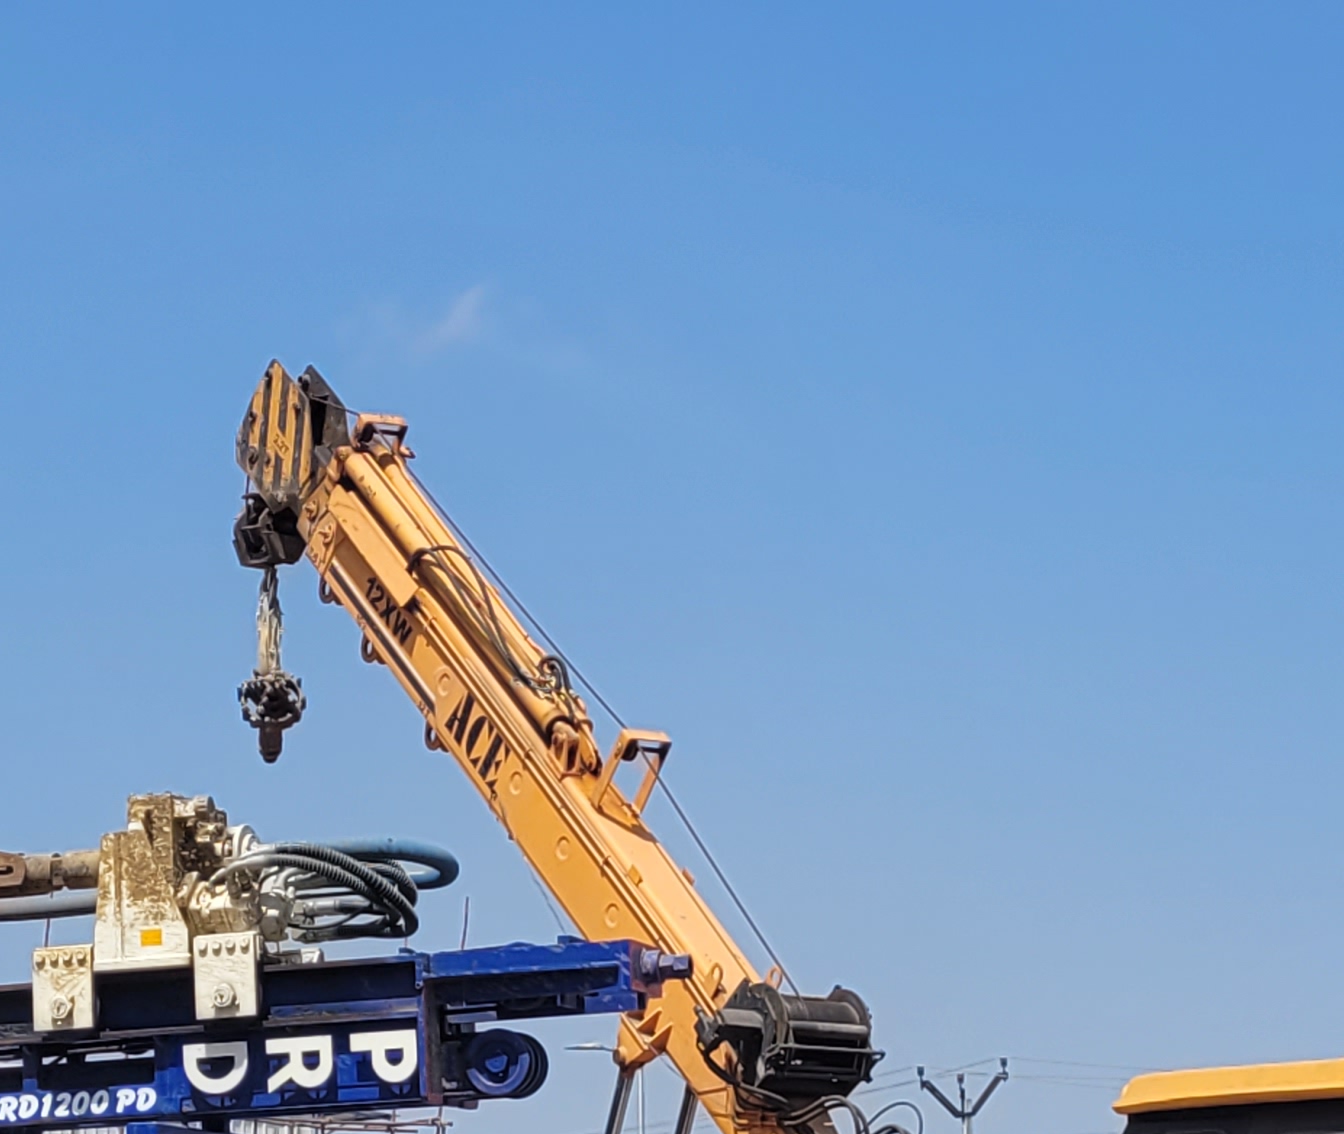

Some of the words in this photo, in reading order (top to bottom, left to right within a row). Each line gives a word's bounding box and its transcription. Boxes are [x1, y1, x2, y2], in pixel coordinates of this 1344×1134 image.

[366, 576, 413, 645] 12XW
[445, 690, 511, 788] ACE
[115, 1086, 157, 1114] PD
